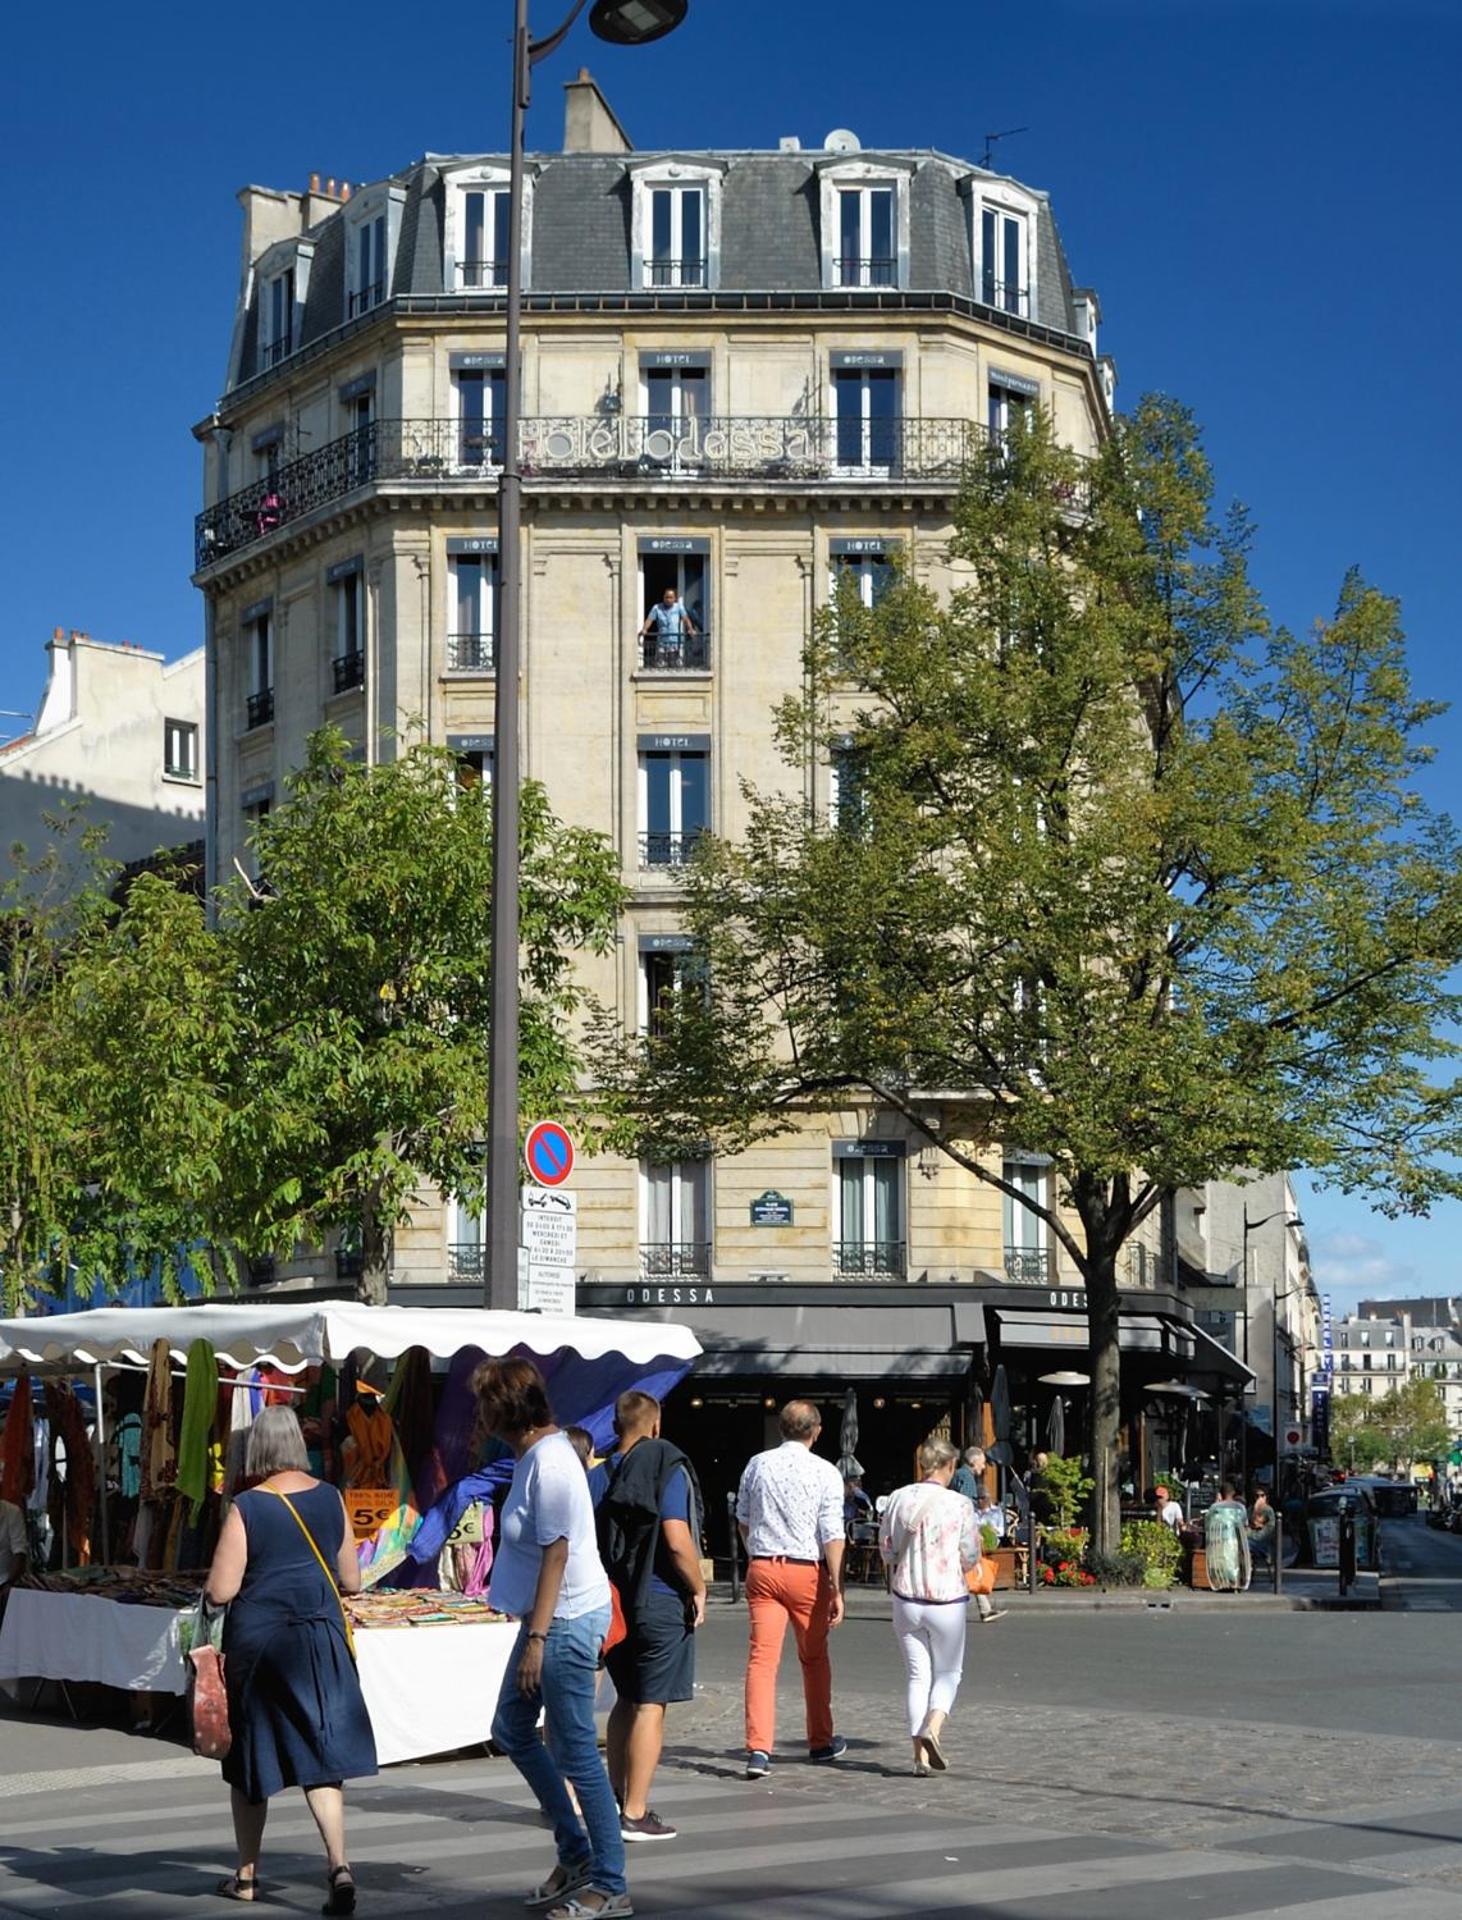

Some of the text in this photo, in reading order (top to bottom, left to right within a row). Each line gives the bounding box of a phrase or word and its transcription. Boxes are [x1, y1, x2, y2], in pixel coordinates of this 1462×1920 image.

[656, 354, 692, 364] HOTEL
[655, 737, 691, 747] HOTEL
[626, 1288, 714, 1303] ODESSA
[1050, 1292, 1088, 1307] ODES
[354, 1508, 389, 1526] 5€
